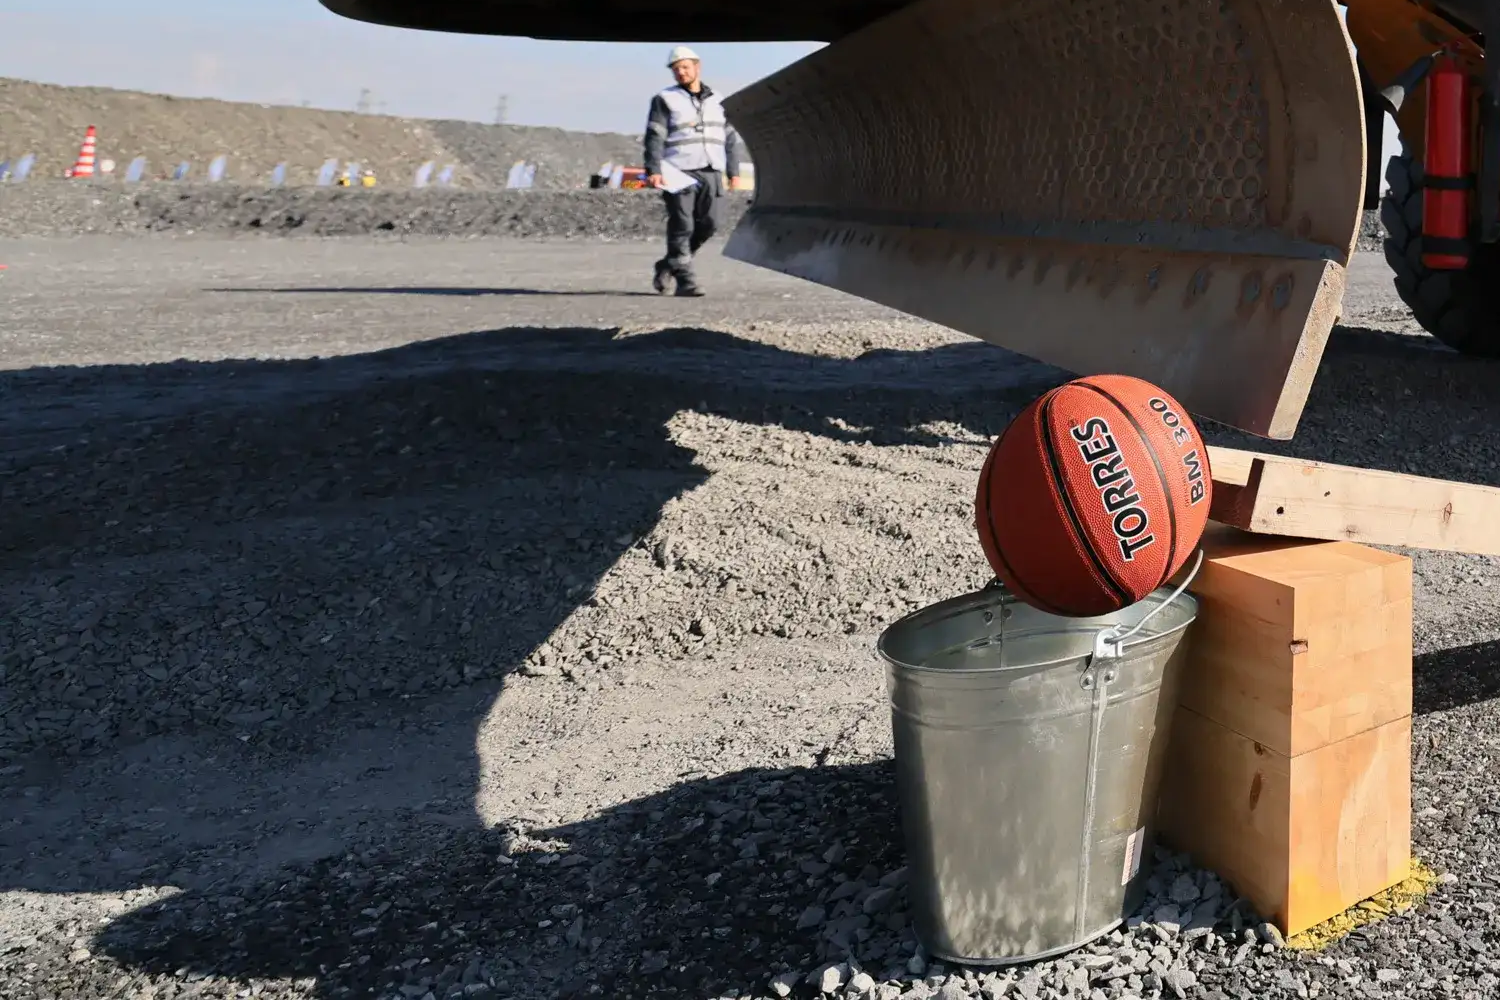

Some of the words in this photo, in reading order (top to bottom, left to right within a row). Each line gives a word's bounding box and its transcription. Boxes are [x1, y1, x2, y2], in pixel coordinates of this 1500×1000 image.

[1148, 397, 1191, 447] 300
[1070, 416, 1155, 562] TORRES
[1183, 449, 1205, 506] BM
